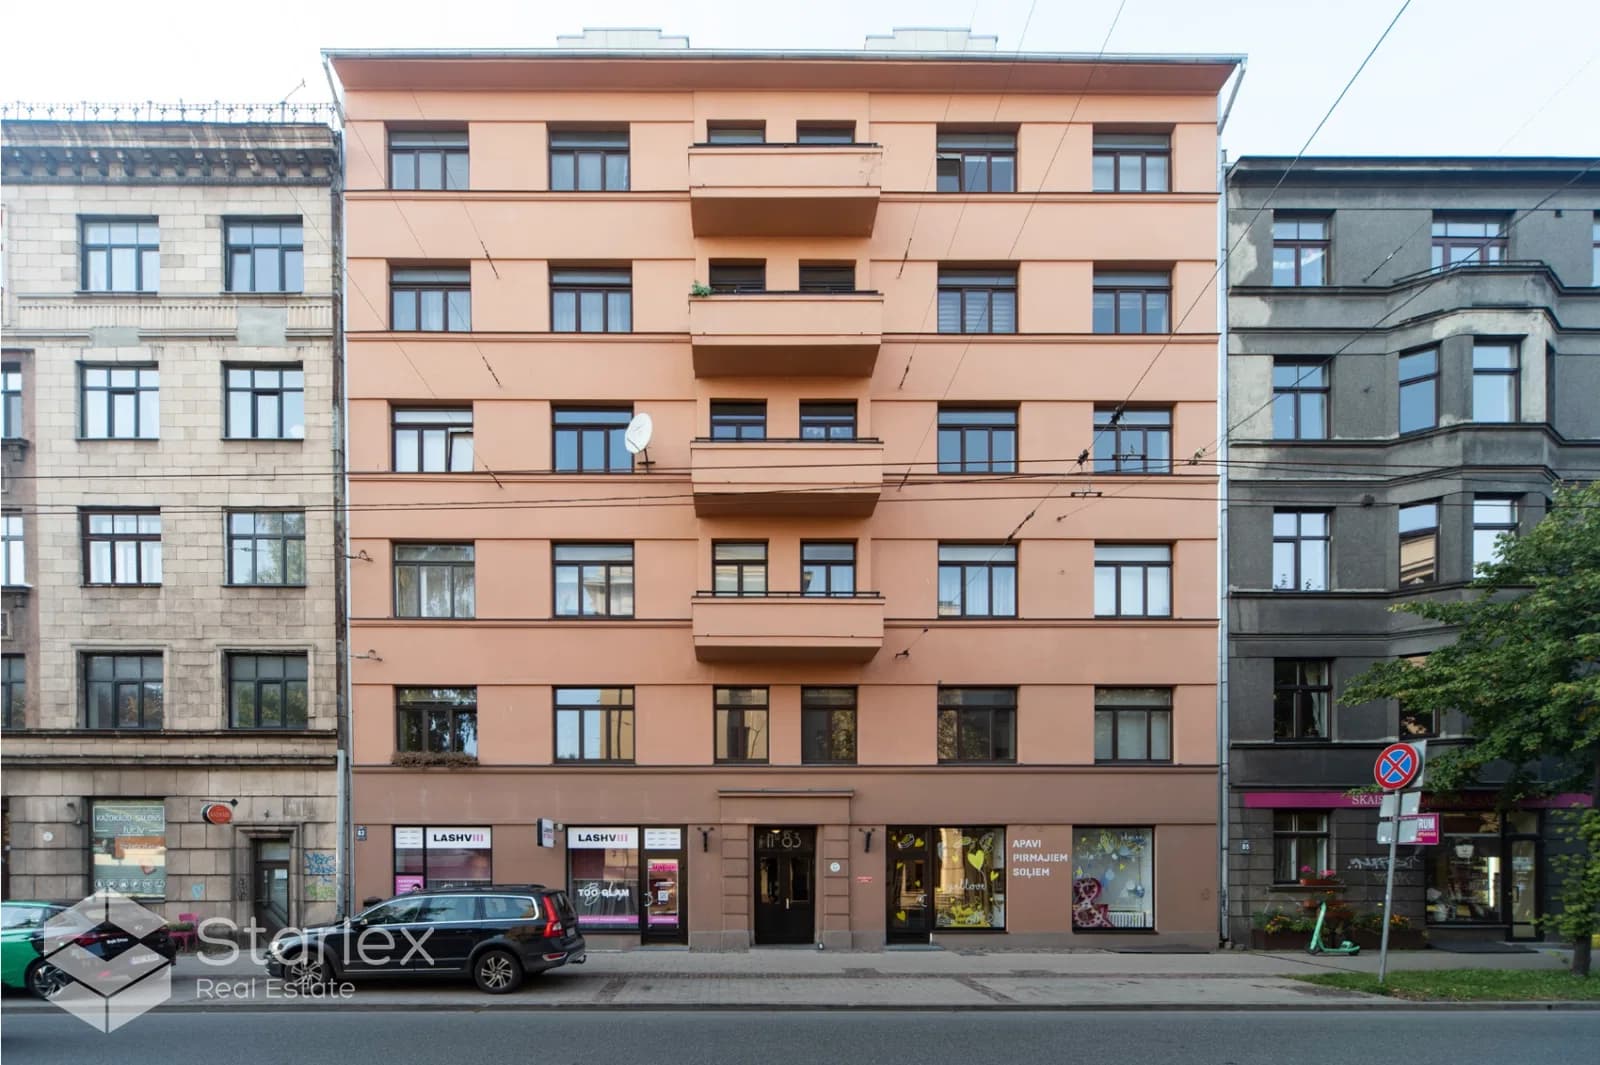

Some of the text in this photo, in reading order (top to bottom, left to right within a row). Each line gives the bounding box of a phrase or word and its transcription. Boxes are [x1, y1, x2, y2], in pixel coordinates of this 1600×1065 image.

[433, 834, 484, 842] LASHVIII
[578, 834, 628, 842] LASHVIII
[1012, 839, 1041, 849] APAVI
[1012, 853, 1068, 863] PIRMAJIEM
[1012, 867, 1050, 879] SOĻIEM
